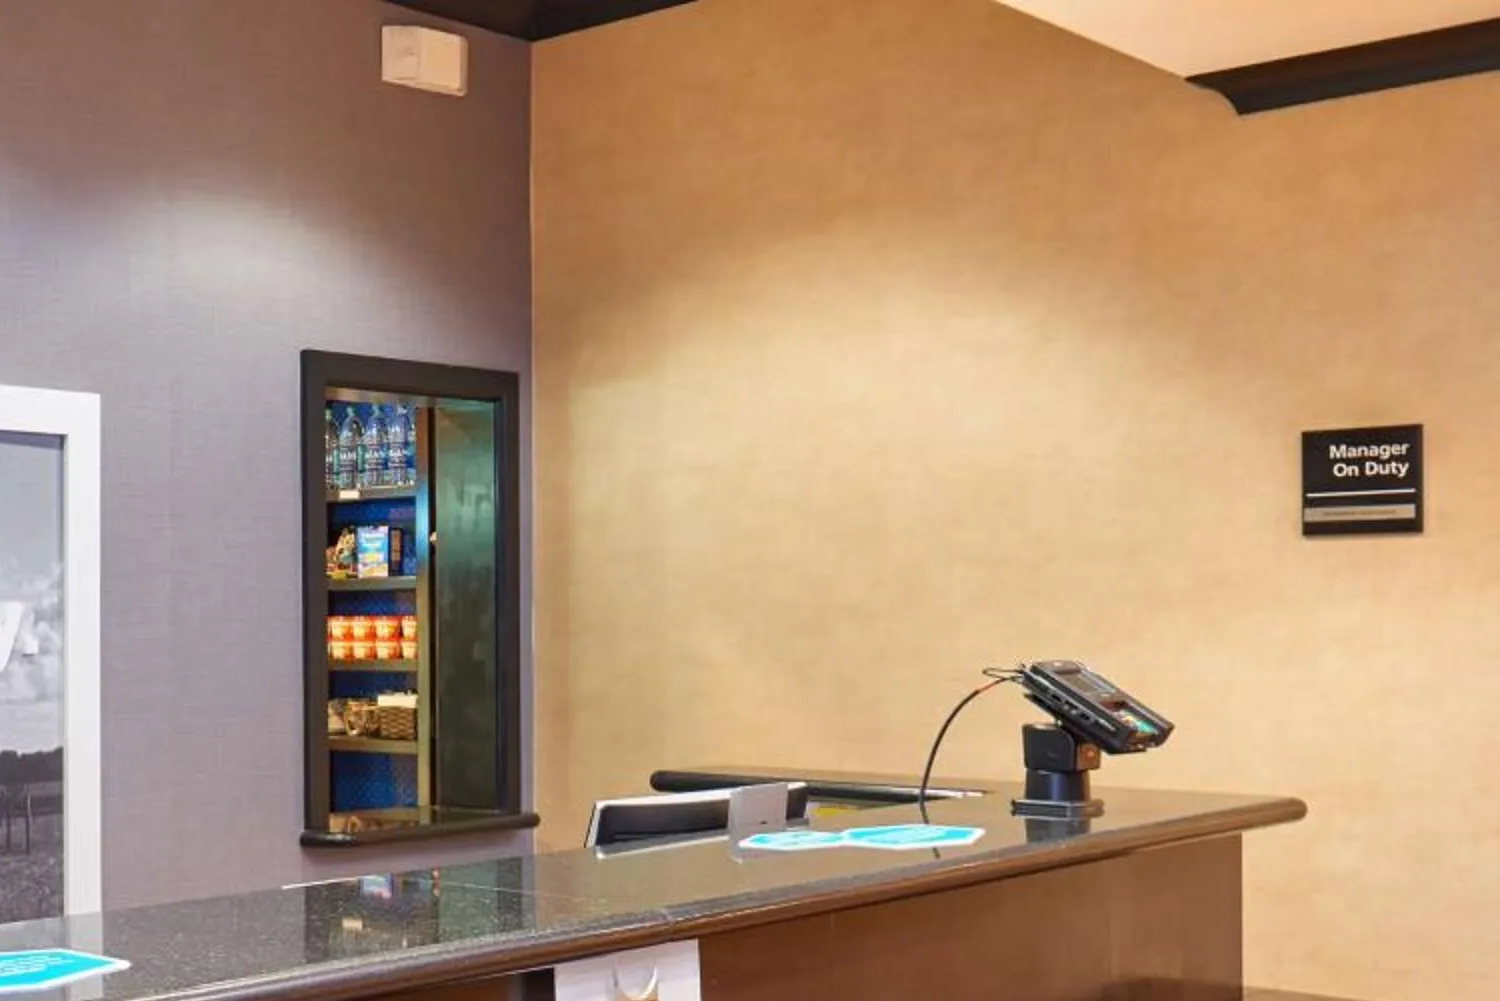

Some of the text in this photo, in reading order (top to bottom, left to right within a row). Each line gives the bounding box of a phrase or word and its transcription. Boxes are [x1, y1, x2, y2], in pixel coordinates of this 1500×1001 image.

[1329, 443, 1411, 460] Manager
[1333, 461, 1410, 478] On Duty
